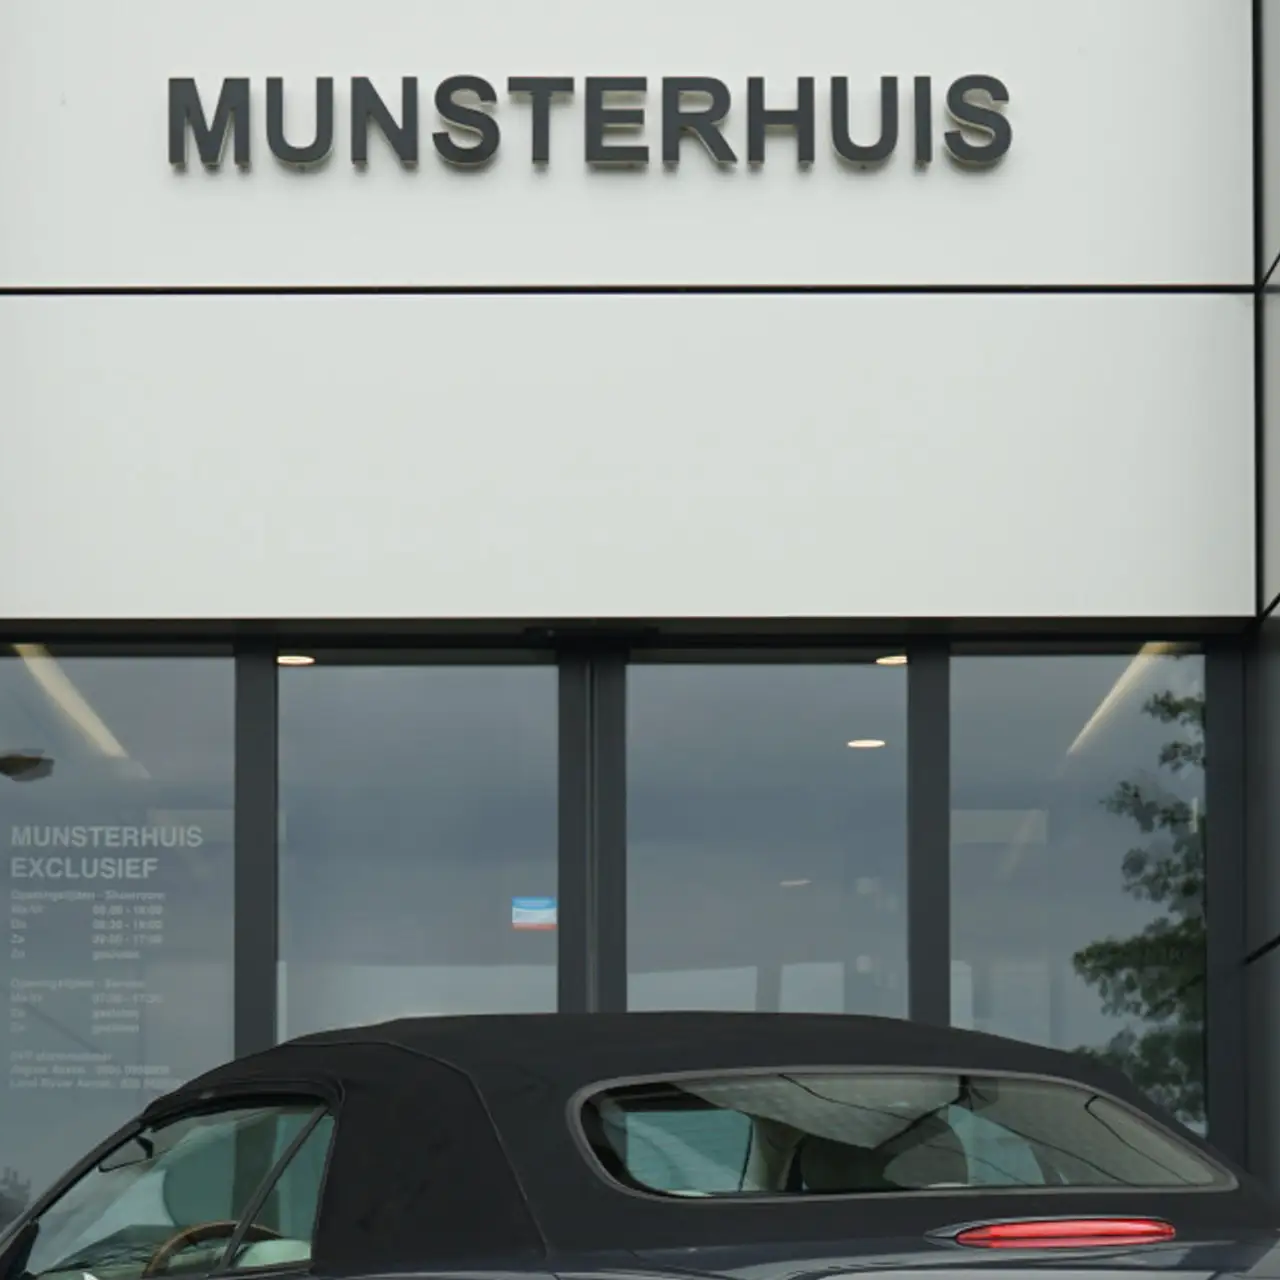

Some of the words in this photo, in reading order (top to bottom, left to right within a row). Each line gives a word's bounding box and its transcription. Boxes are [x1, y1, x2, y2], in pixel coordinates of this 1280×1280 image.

[167, 74, 1014, 172] MUNSTERHUIS
[10, 825, 204, 848] MUNSTERHUIS
[10, 856, 160, 880] EXCLUSIEF
